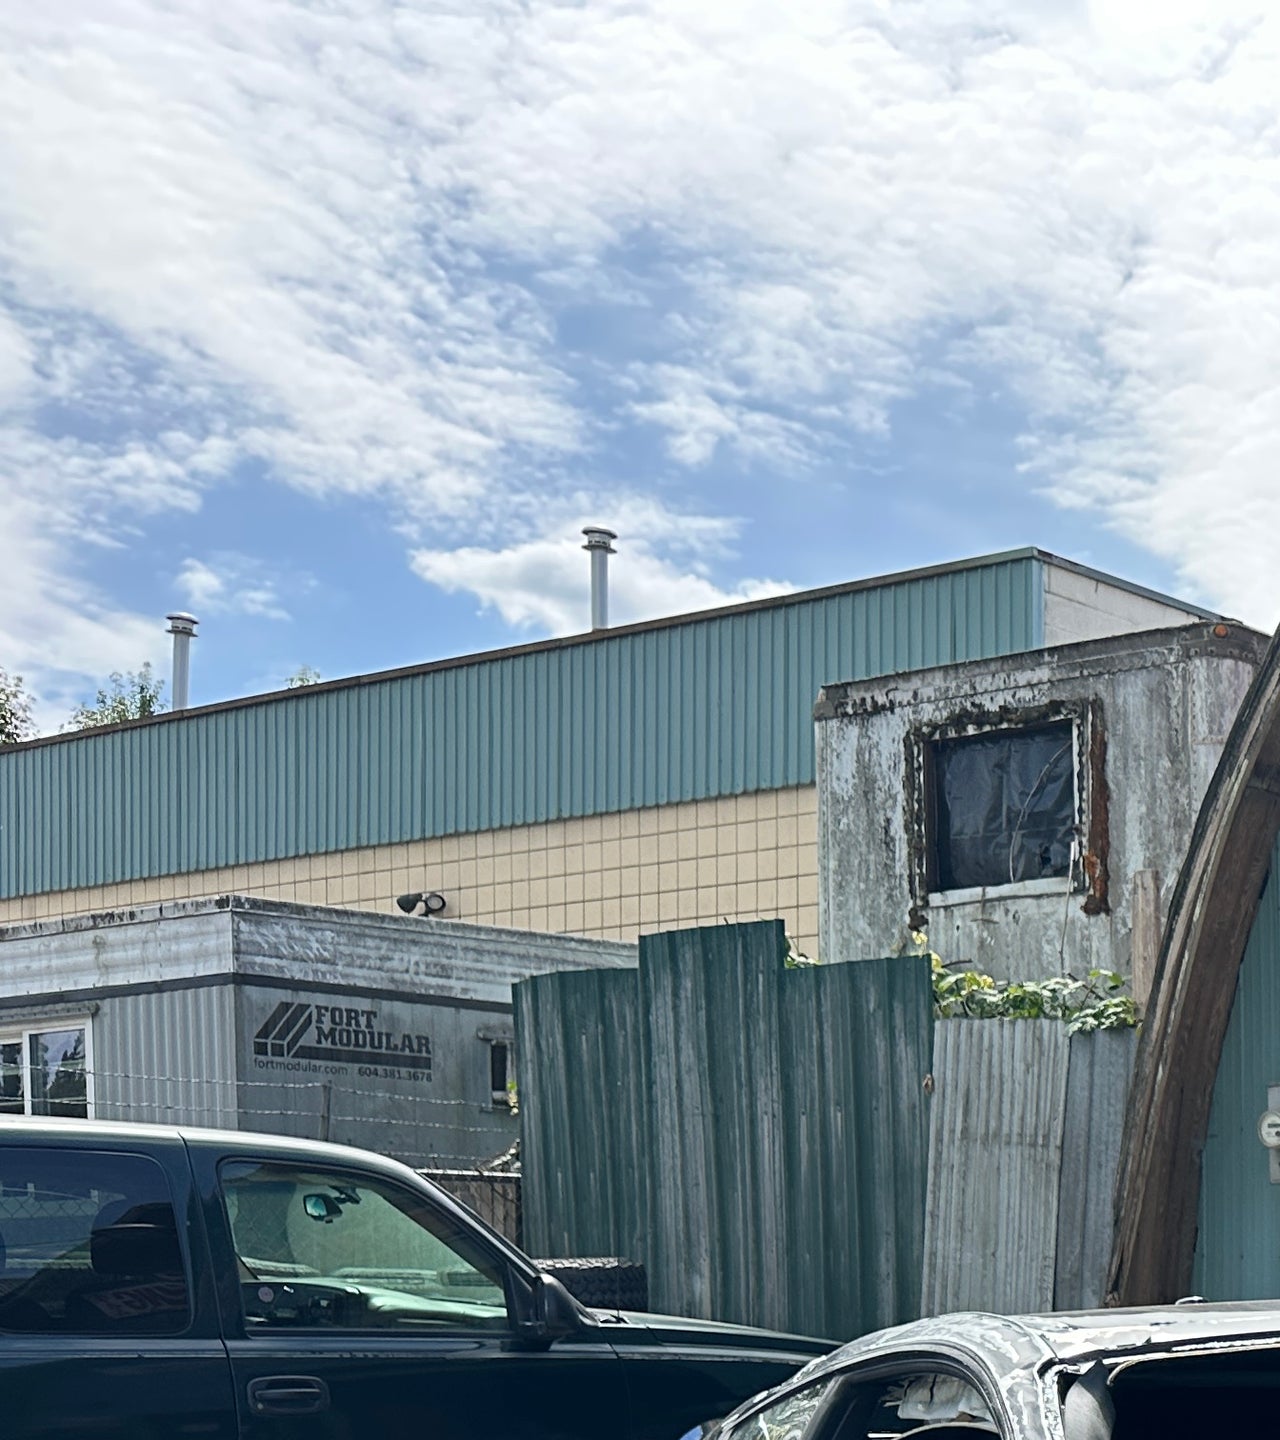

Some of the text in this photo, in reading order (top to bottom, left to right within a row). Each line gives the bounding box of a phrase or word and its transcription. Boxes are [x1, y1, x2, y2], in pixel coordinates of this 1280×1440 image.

[315, 1005, 377, 1030] FORT
[316, 1026, 432, 1055] MODULAR
[253, 1057, 433, 1083] fortmodular.com 604.381.3678
